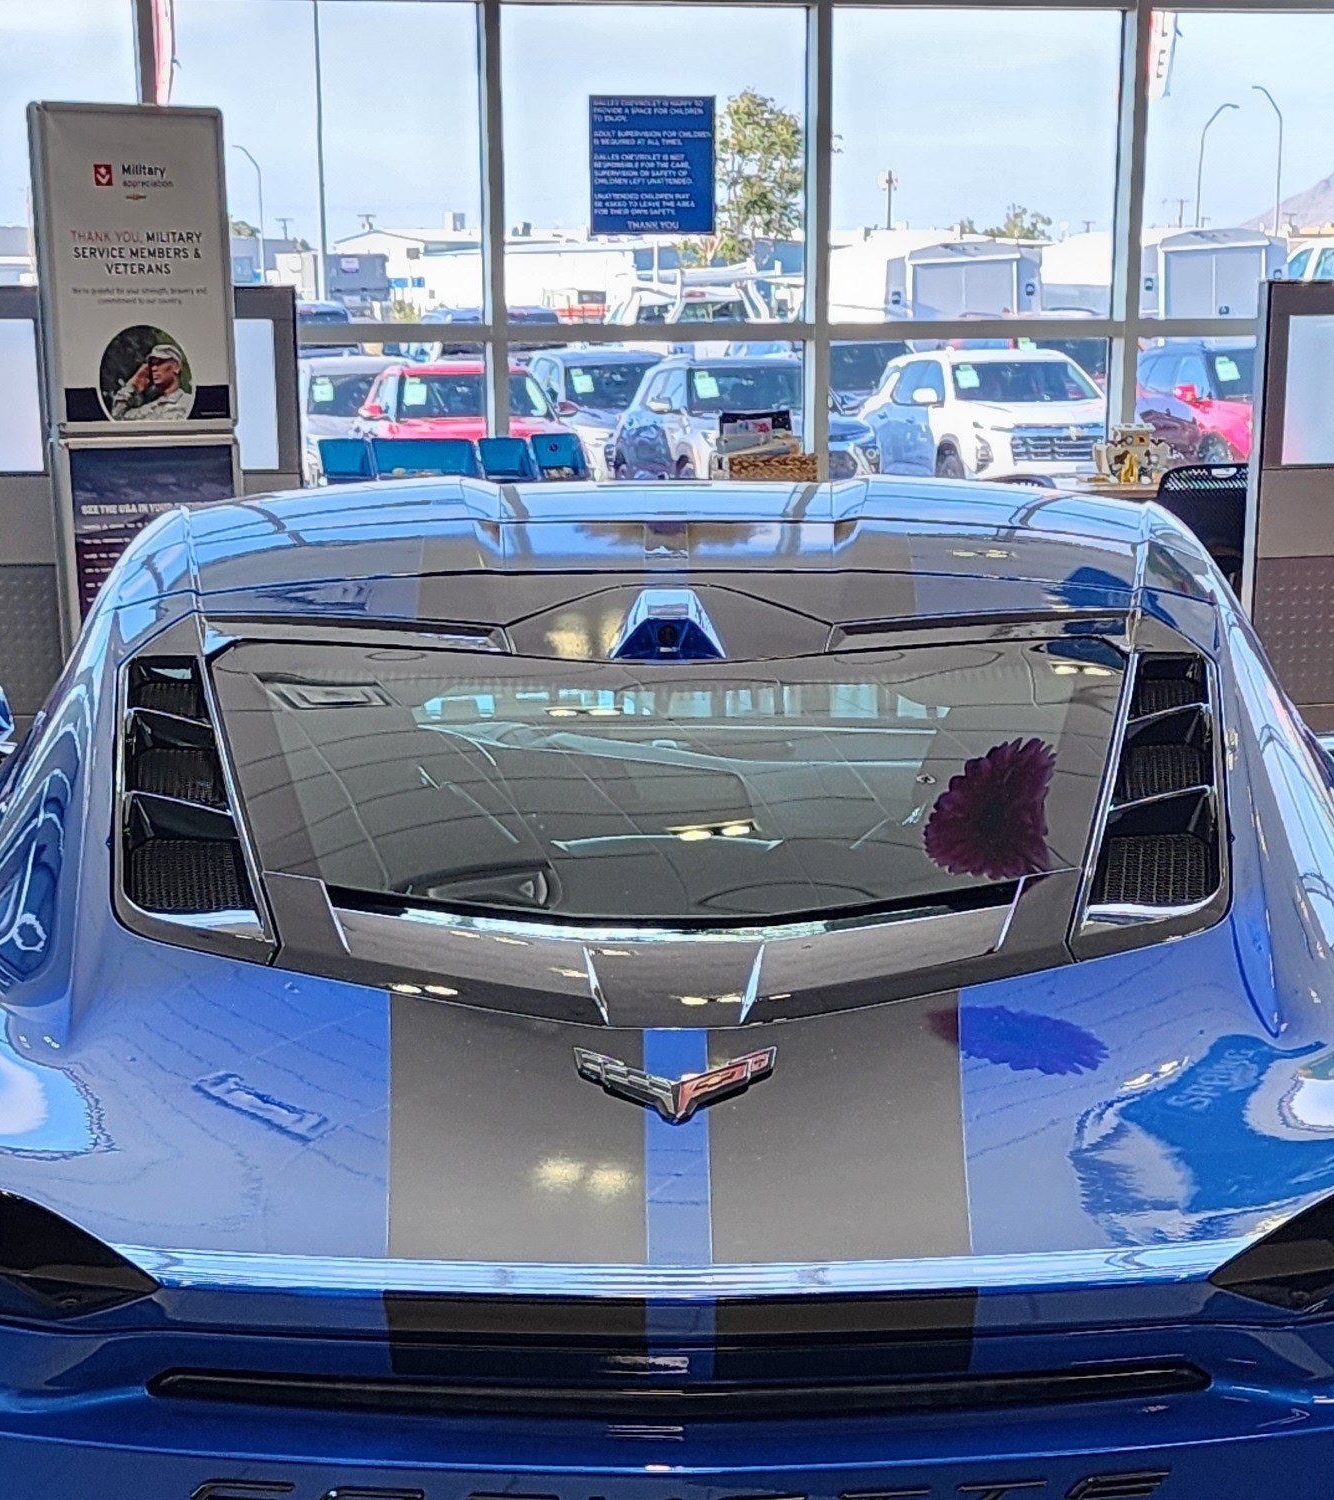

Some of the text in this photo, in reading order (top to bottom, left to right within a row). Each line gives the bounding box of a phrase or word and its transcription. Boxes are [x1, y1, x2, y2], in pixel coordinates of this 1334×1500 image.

[121, 164, 166, 179] Military
[122, 180, 174, 189] appreciation
[627, 220, 680, 230] THANK YOU
[70, 230, 202, 245] THANK YOU, MILITARY
[73, 247, 202, 260] SERVICE MEMBERS &
[105, 263, 172, 275] VETERANS
